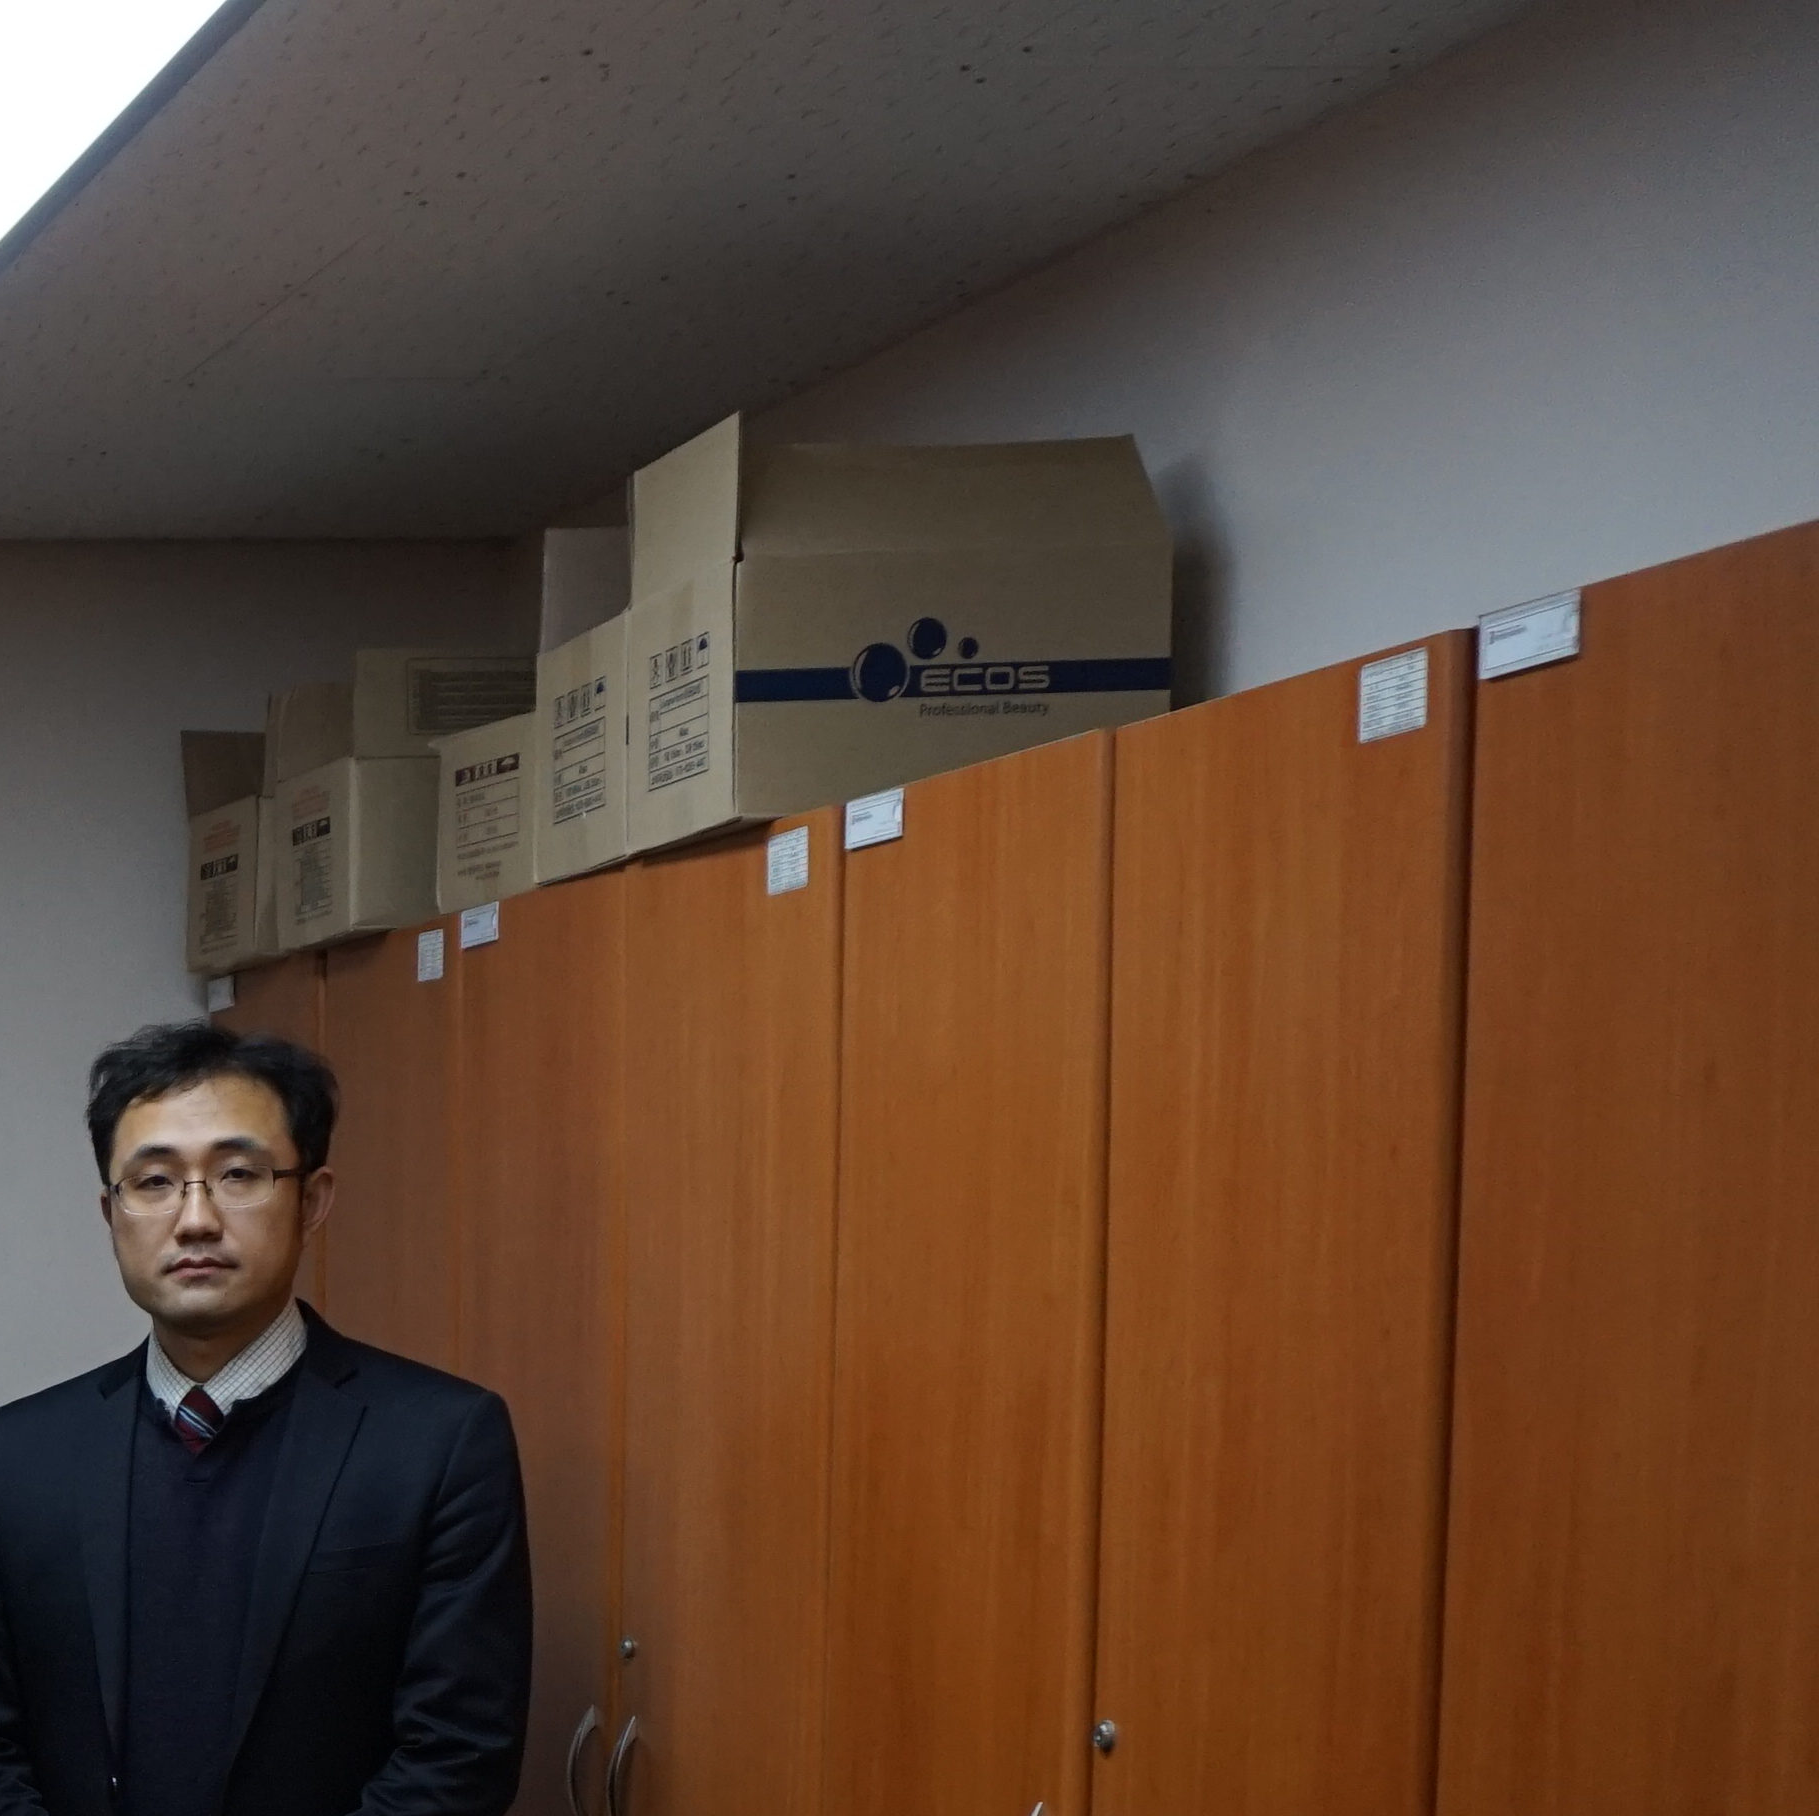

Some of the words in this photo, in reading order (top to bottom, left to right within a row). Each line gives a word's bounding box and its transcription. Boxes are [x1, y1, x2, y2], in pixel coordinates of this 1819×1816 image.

[920, 664, 1050, 692] ECOS
[919, 702, 999, 717] Professional
[1004, 701, 1050, 716] Beauty
